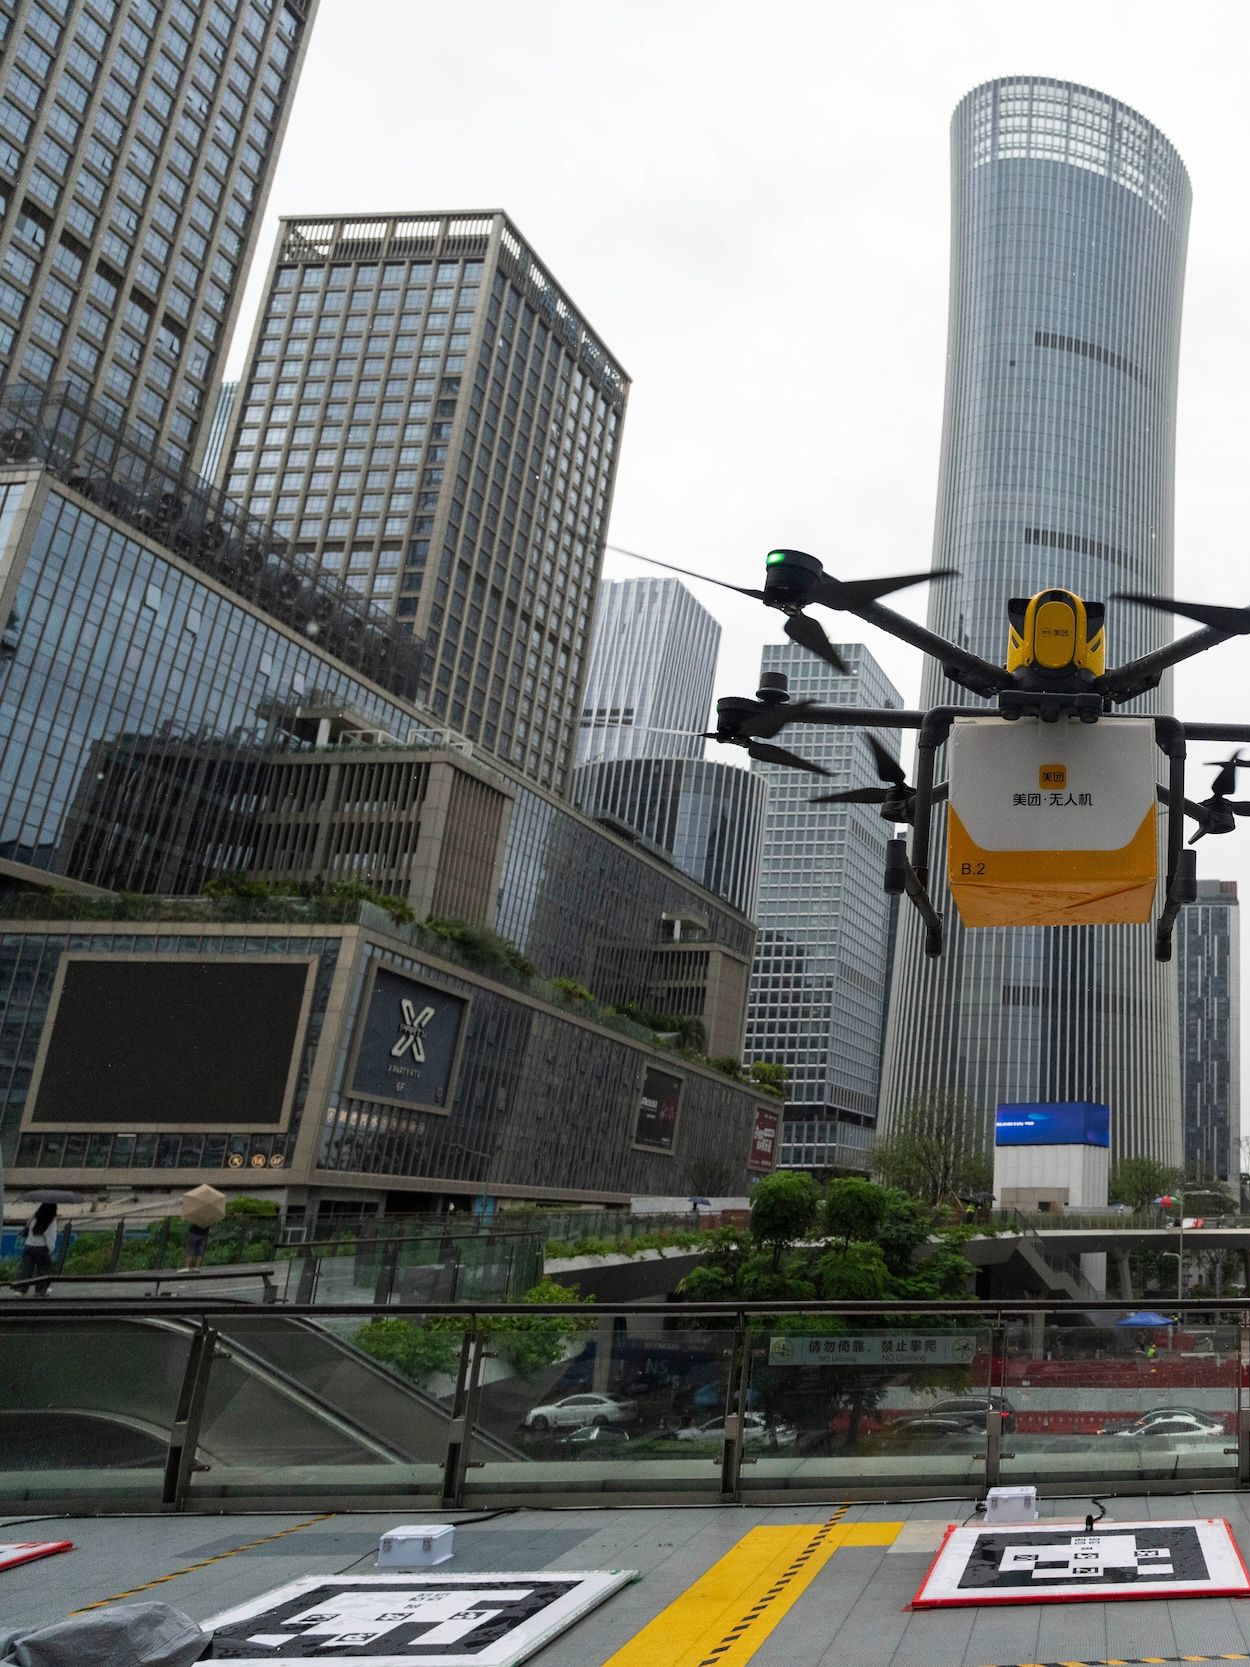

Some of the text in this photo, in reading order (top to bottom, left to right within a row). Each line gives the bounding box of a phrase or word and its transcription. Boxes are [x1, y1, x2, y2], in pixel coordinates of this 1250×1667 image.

[1042, 771, 1065, 782] 美团
[1013, 793, 1093, 807] 美团·无人机
[961, 862, 985, 875] B.2
